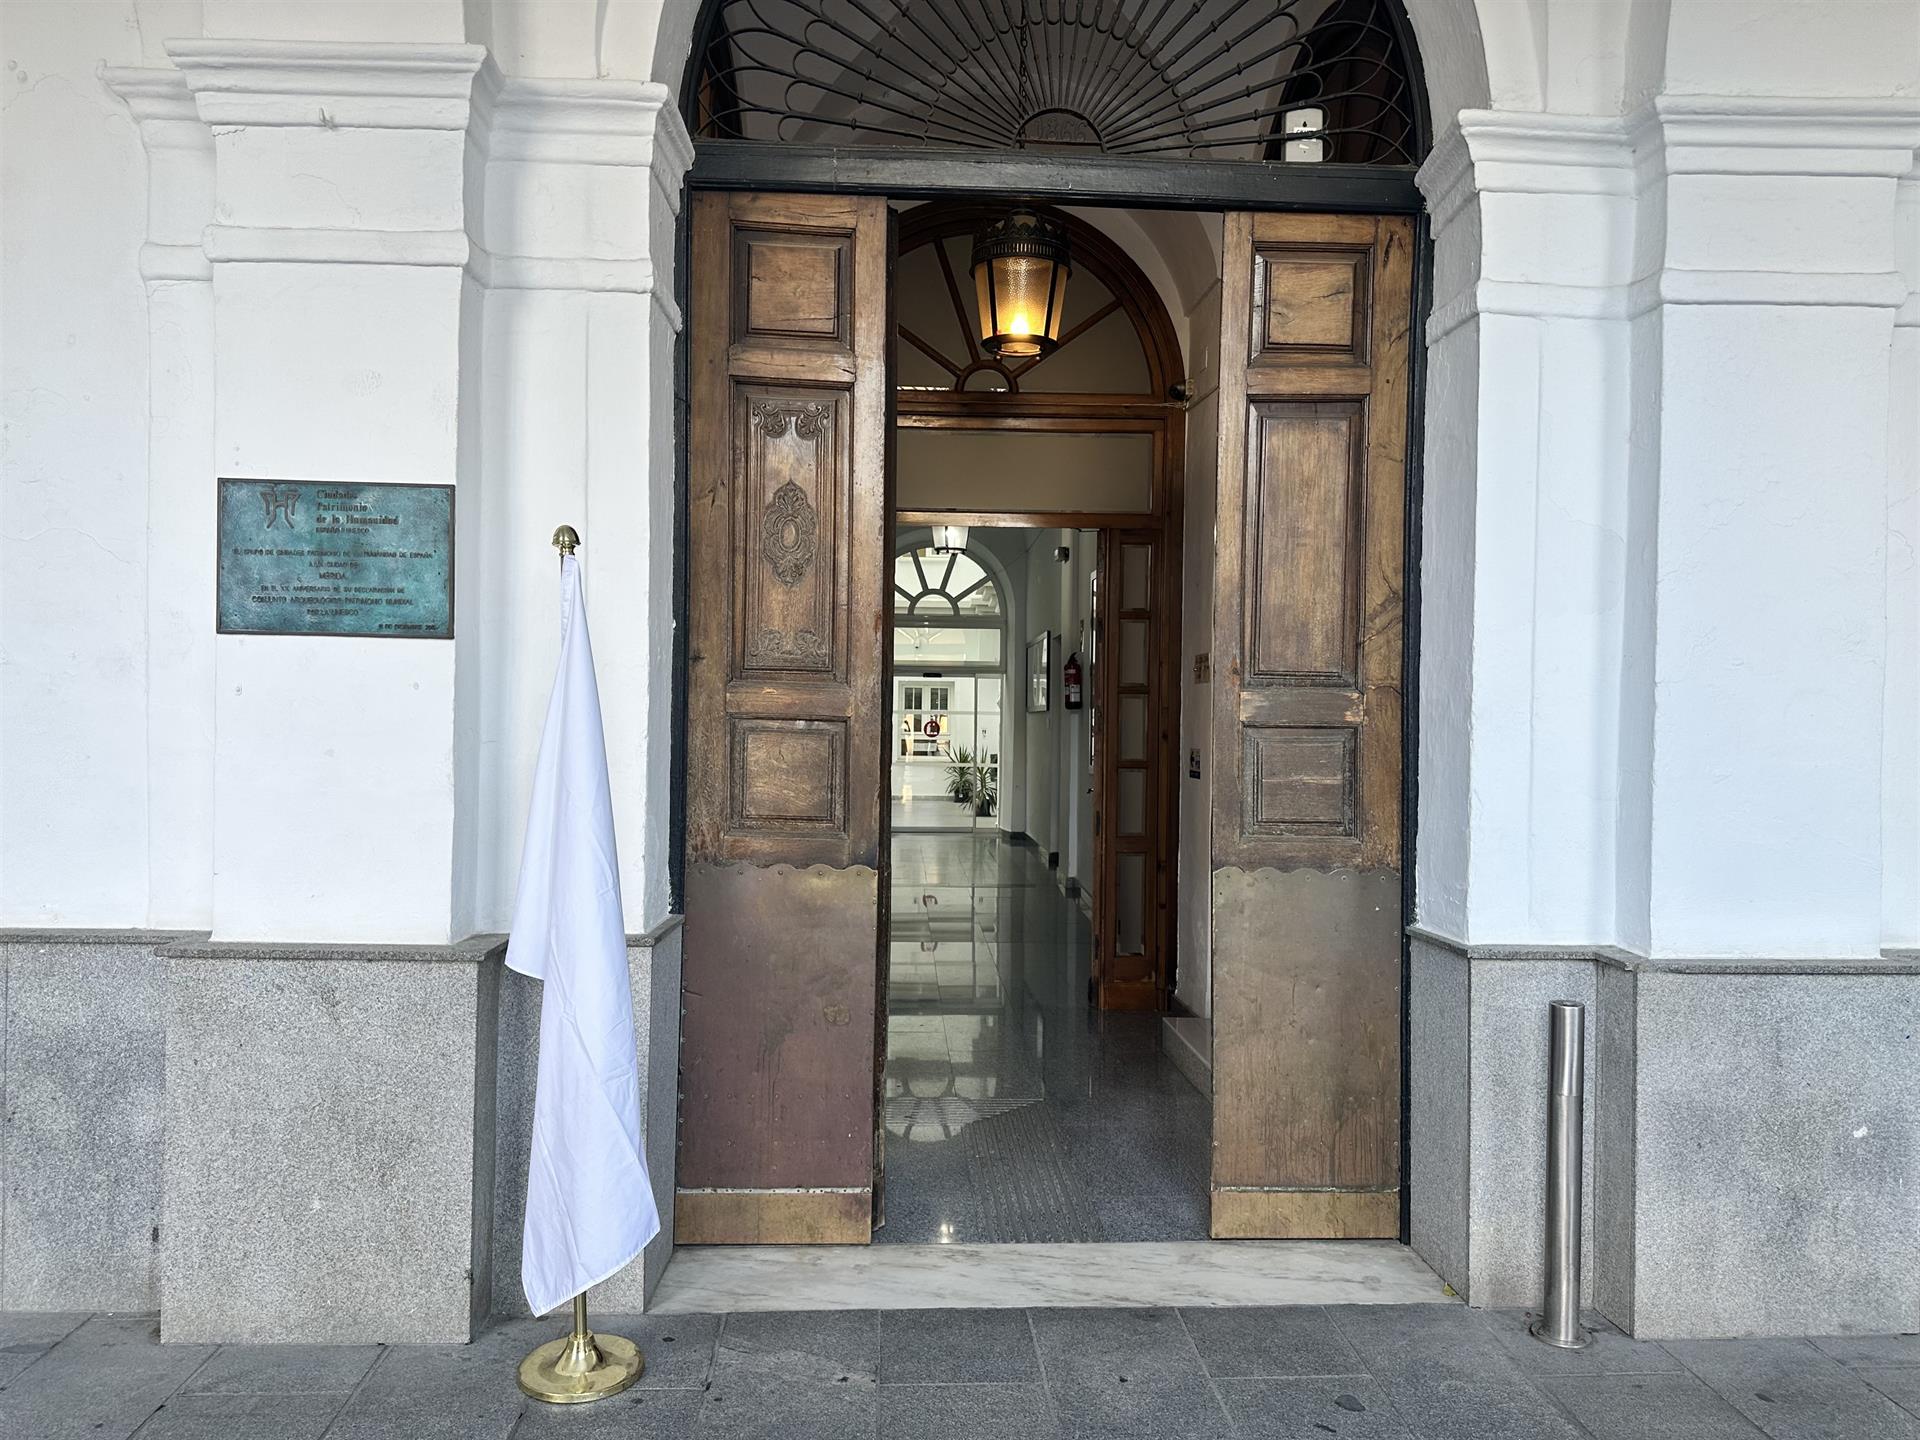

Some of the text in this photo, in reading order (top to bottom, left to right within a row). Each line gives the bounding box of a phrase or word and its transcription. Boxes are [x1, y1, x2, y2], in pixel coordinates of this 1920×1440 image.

[317, 502, 369, 512] Patrimonio
[316, 514, 327, 524] de
[346, 515, 399, 525] Humanidad
